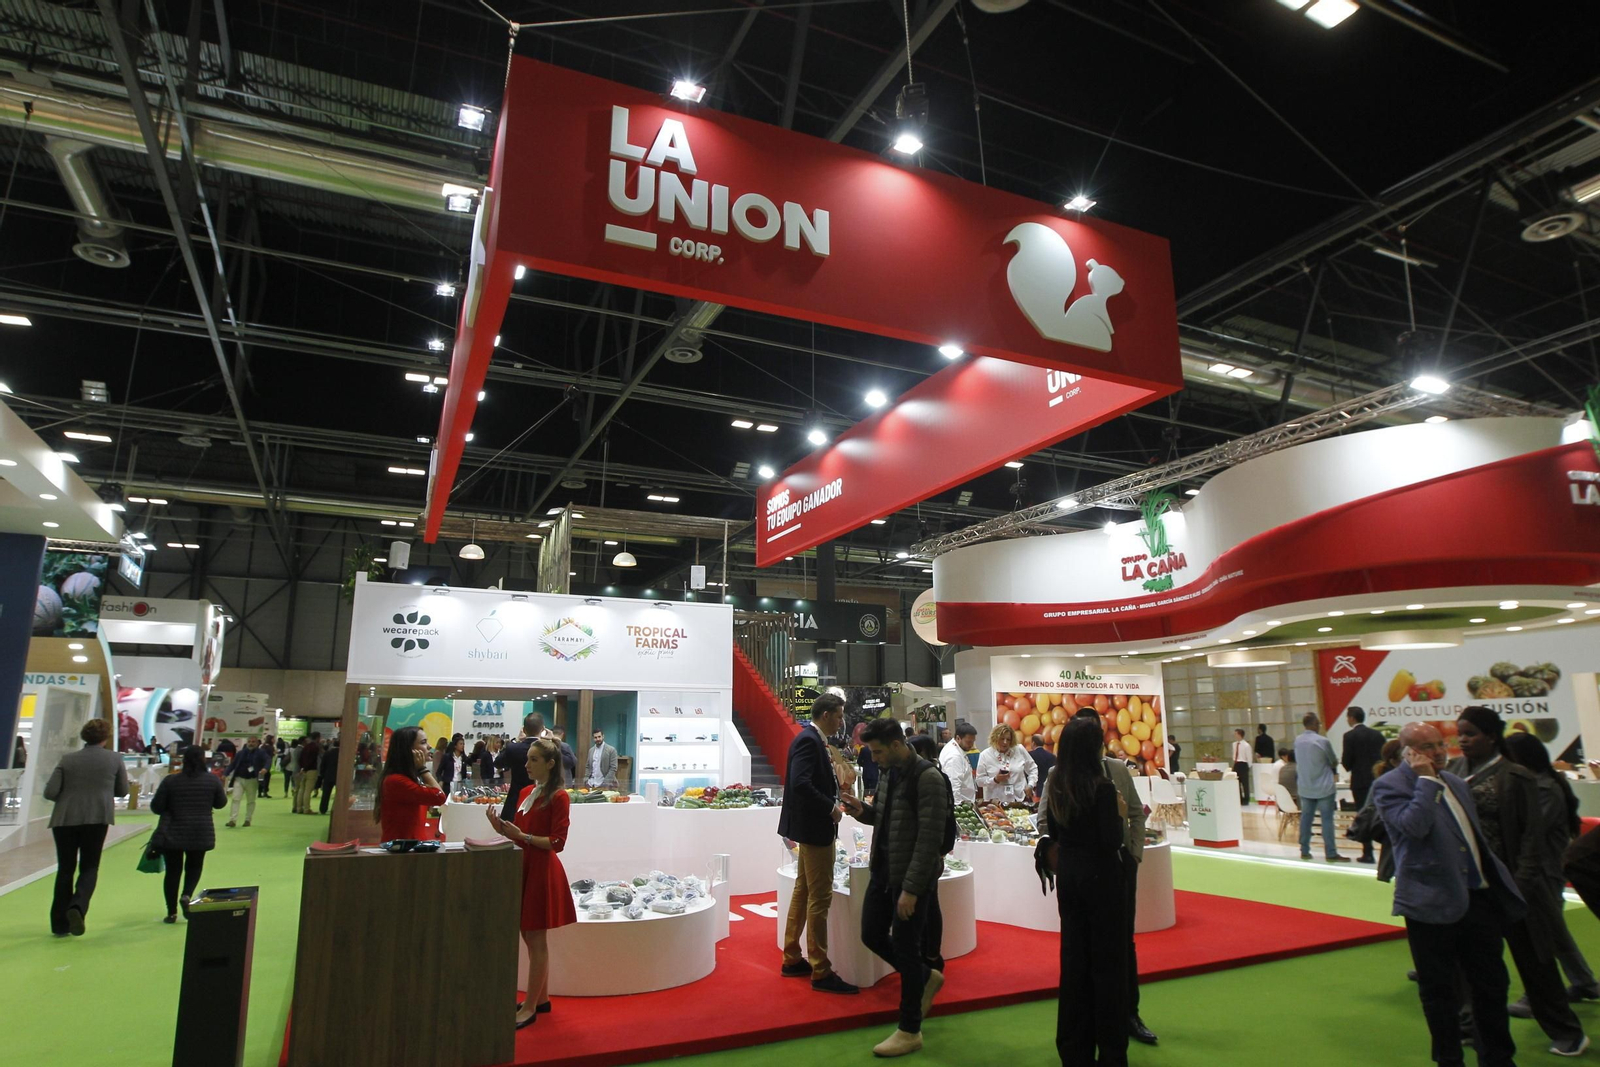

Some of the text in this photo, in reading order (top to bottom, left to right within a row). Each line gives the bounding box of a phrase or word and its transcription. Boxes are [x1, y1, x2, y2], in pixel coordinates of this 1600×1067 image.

[609, 105, 697, 175] LA
[608, 158, 830, 258] UNION
[669, 236, 725, 265] CORP.
[767, 489, 790, 515] SOMOS
[767, 478, 843, 532] TU EQUIPO GANADOR
[1121, 551, 1188, 581] LA CAÑA
[1067, 607, 1111, 617] EMPRESARIAL
[1120, 603, 1137, 612] CAÑA
[382, 626, 440, 637] wecarepack
[626, 625, 688, 639] TROPICAL
[635, 637, 679, 650] FARMS
[1059, 670, 1072, 680] 40
[1018, 680, 1055, 689] PONIENDO
[1056, 681, 1079, 689] SABOR
[1125, 682, 1140, 690] VIDA
[472, 699, 505, 716] SAT
[1368, 703, 1472, 718] AGRICULTUR
[472, 719, 505, 730] Campos
[464, 732, 474, 740] de
